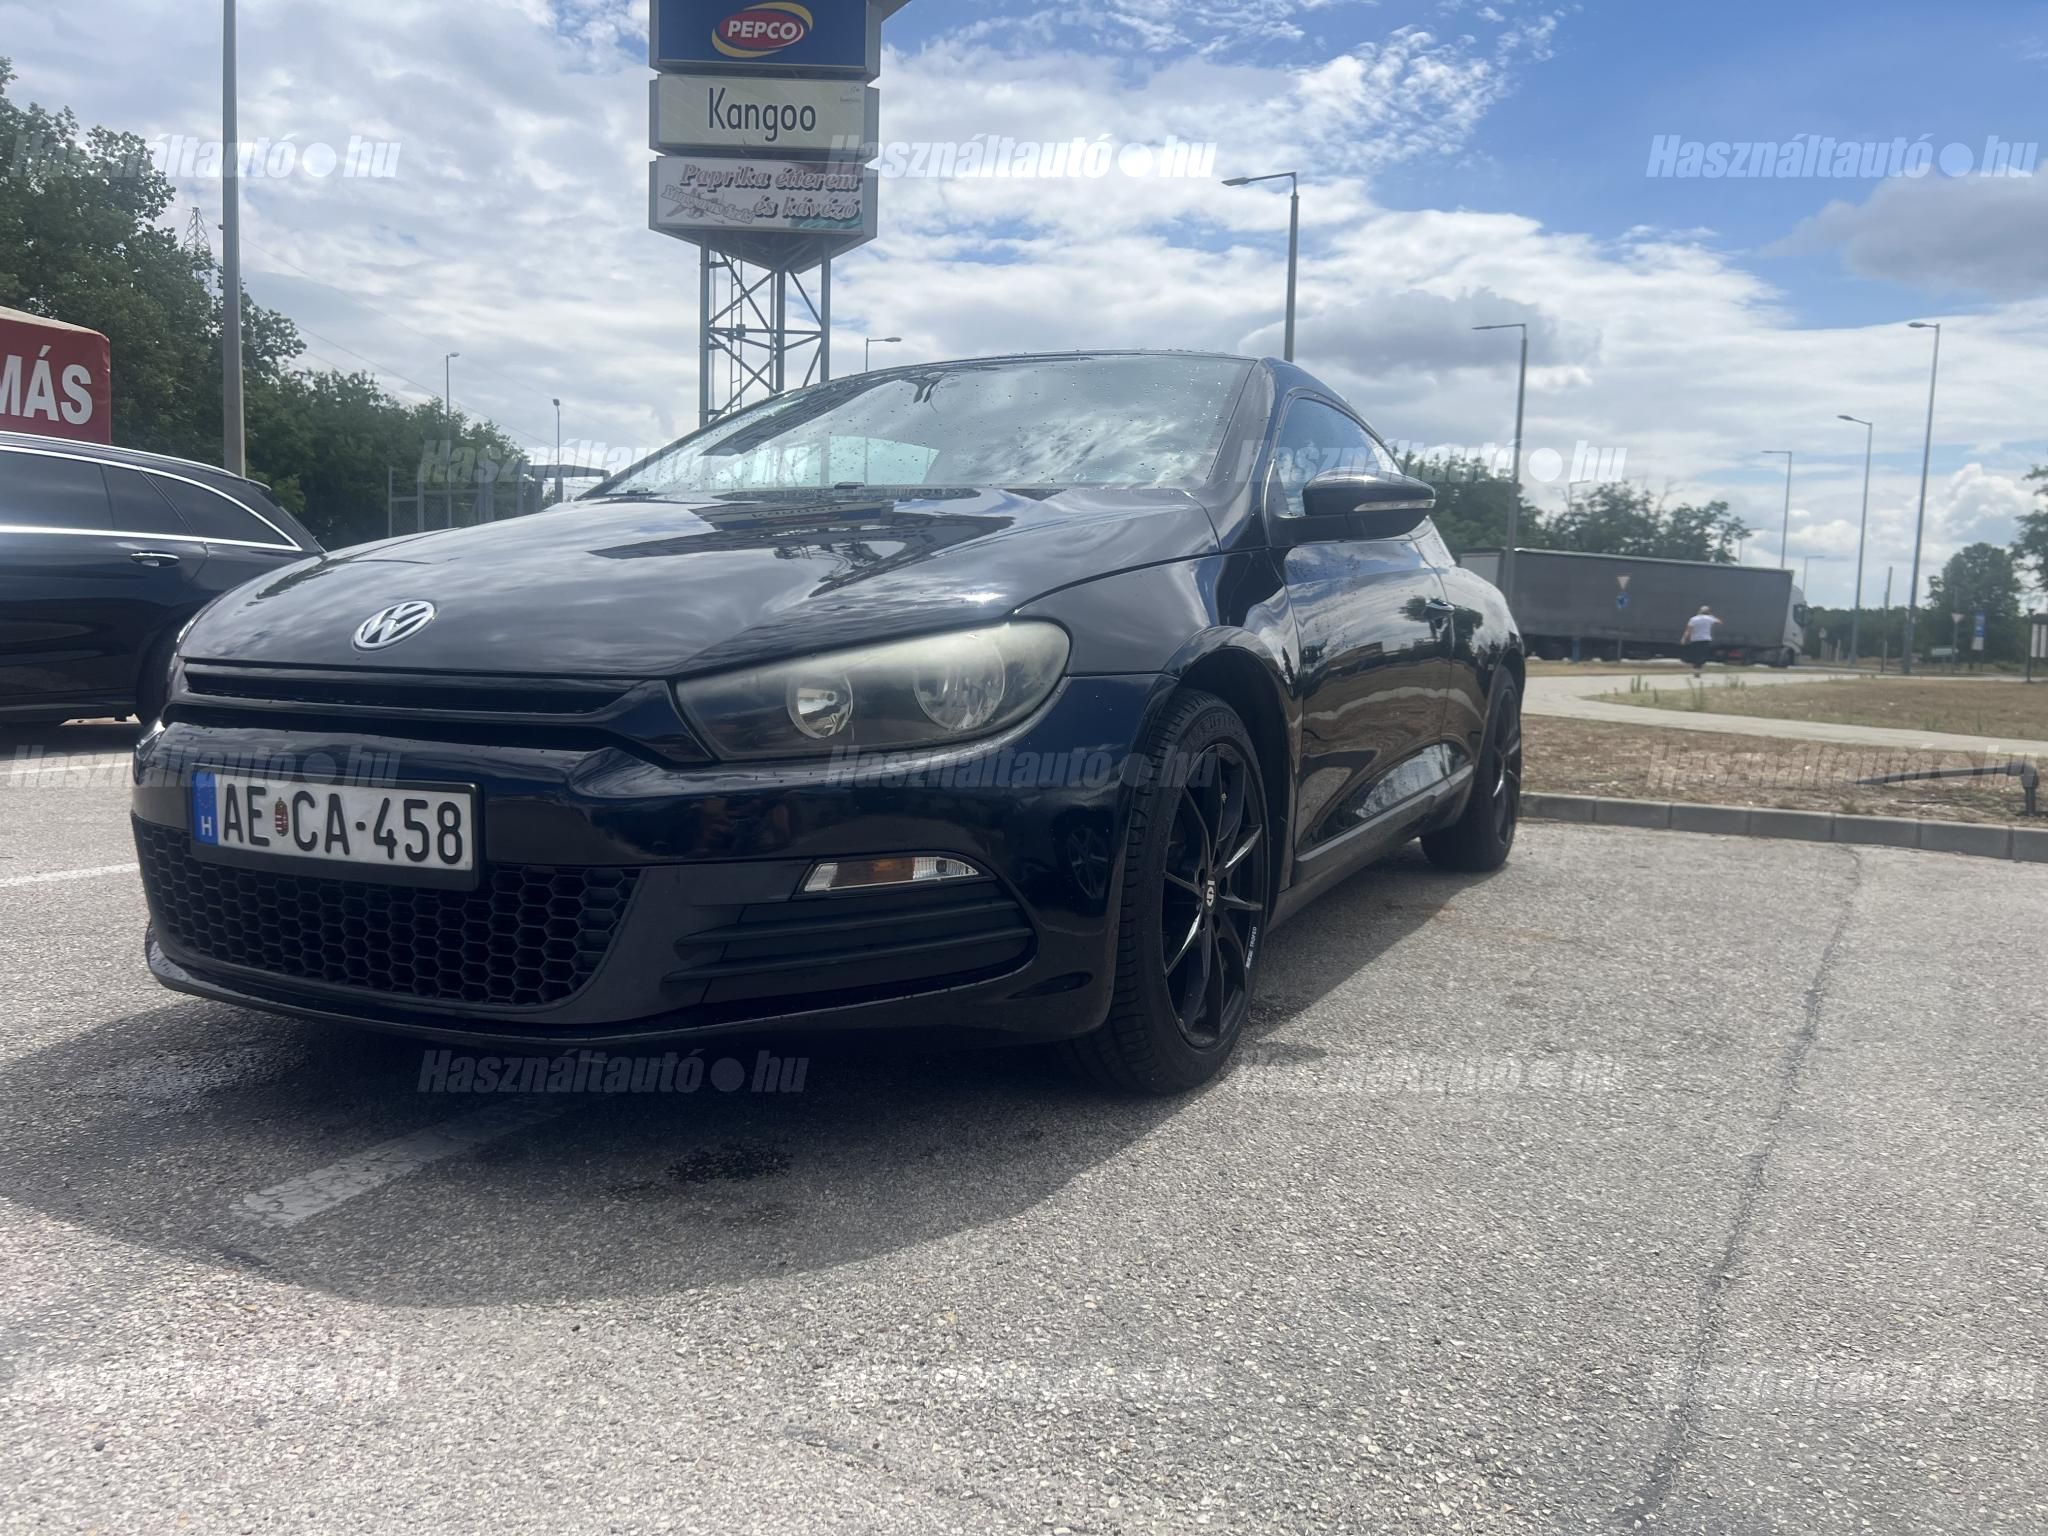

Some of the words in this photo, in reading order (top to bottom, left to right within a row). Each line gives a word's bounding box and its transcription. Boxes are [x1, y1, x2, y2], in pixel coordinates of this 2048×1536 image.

[727, 20, 798, 40] PEPCO
[707, 87, 816, 142] Kangoo
[680, 164, 771, 193] Paprika
[774, 167, 860, 192] étterem
[753, 196, 777, 218] és
[783, 197, 860, 220] kávézó
[201, 816, 213, 837] H
